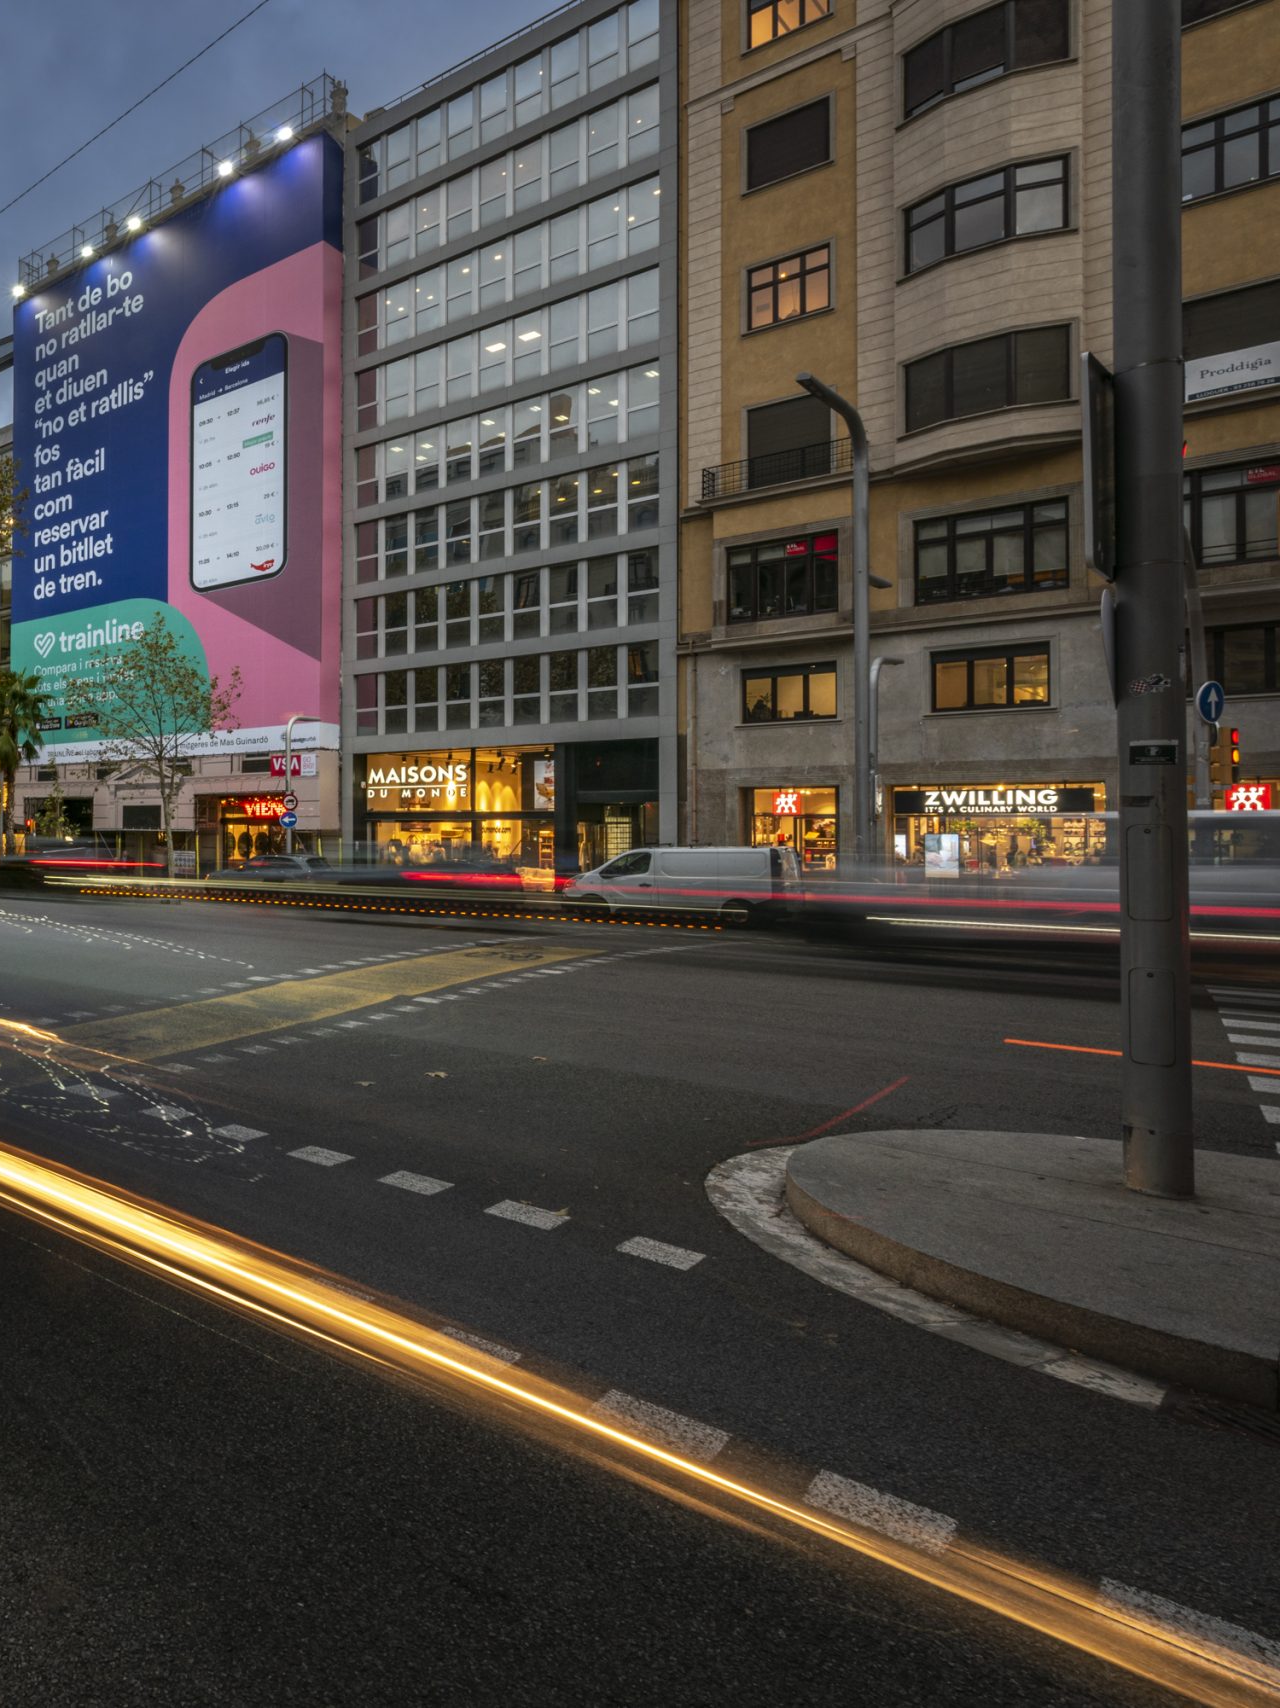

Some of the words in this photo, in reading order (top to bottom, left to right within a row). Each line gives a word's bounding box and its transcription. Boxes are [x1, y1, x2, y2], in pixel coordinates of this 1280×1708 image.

[34, 298, 74, 334] Tant
[77, 285, 102, 312] de
[107, 271, 133, 298] bo
[35, 338, 57, 362] no
[61, 294, 144, 349] ratllar-te
[34, 354, 79, 391] quan
[34, 390, 52, 415] et
[55, 368, 108, 406] diuen
[198, 390, 216, 400] Madrid
[224, 378, 249, 391] Barcelona
[67, 401, 87, 428] et
[251, 413, 276, 427] renfe
[34, 444, 61, 468] fos
[34, 470, 62, 494] tan
[65, 447, 106, 483] fàcil
[34, 493, 73, 521] com
[34, 509, 109, 548] reservar
[34, 554, 56, 574] un
[60, 533, 113, 568] bitllet
[33, 577, 56, 601] de
[59, 569, 103, 595] tren.
[58, 618, 145, 653] trainline
[33, 661, 77, 678] Compara
[53, 677, 67, 690] els
[210, 739, 219, 747] de
[367, 764, 468, 784] MAISONS
[367, 788, 388, 798] DU
[401, 787, 467, 798] MONDE
[924, 789, 1059, 806] ZWILLING
[959, 805, 1014, 813] CULINARY
[1017, 805, 1058, 813] WORLD
